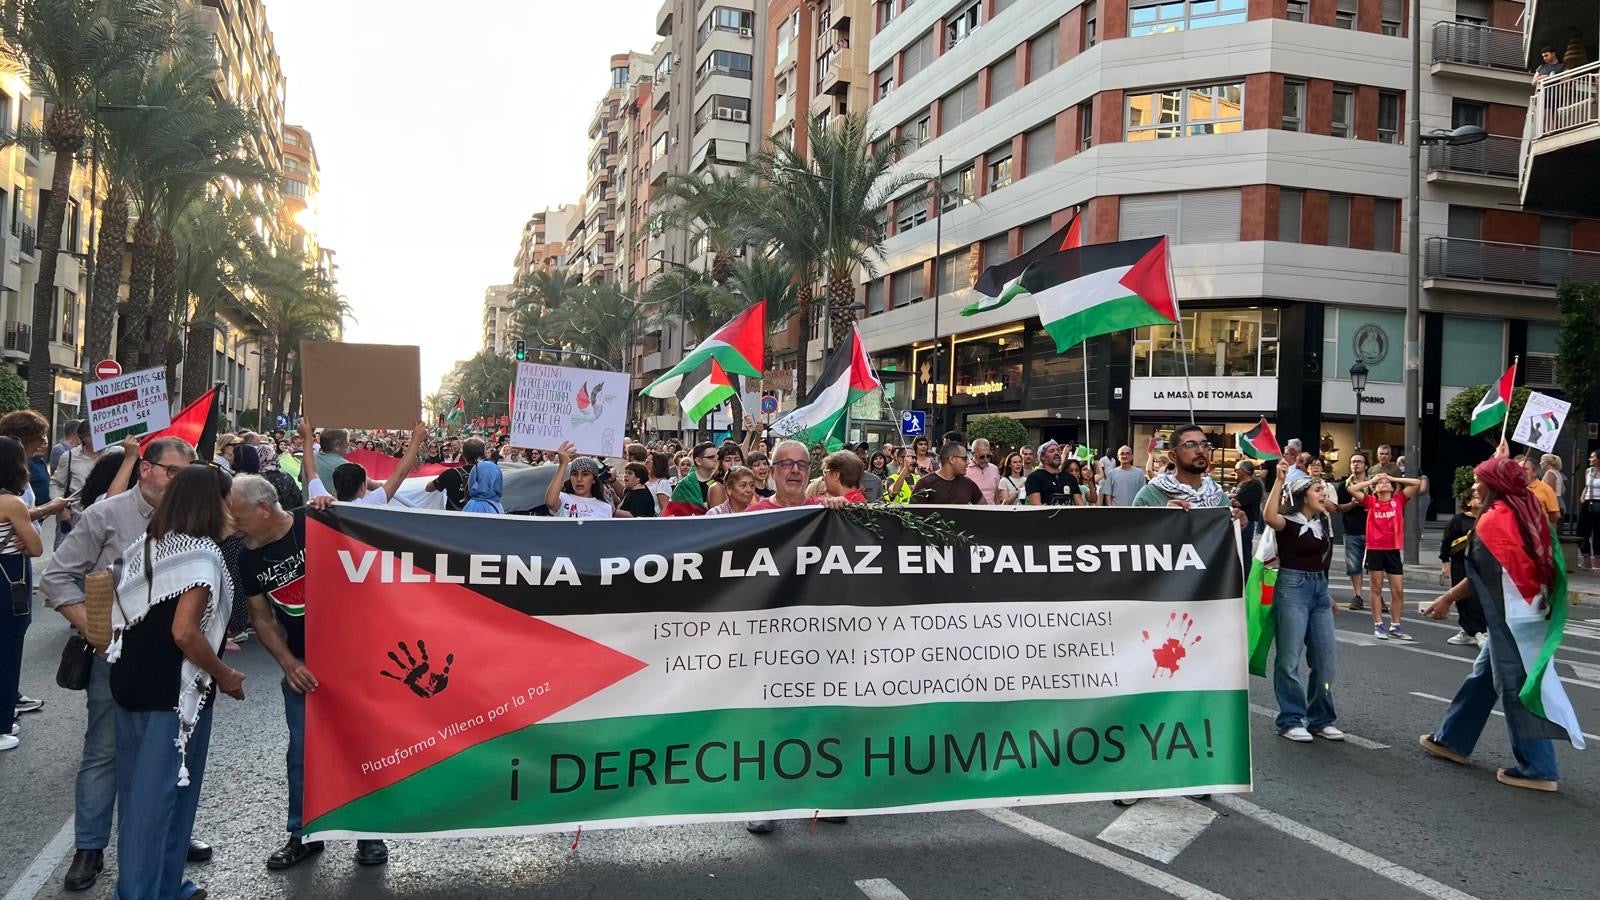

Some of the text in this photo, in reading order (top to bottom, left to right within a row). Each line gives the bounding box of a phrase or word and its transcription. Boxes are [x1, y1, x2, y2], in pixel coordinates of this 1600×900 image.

[96, 371, 165, 396] NO NECESITAS SER
[136, 409, 150, 419] SER
[256, 548, 306, 587] PALESTIN
[276, 570, 298, 586] LIBRE
[337, 543, 1206, 586] VILLENA POR LA PAZ EN PALESTINA
[654, 611, 1112, 640] ¡STOP AL TERRORISMO Y A TODAS LAS VIOLENCIAS!
[666, 642, 1114, 673] ¡ALTO EL FUEGO YA! ¡STOP GENOCIDIO DE ISRAEL!
[763, 672, 1118, 700] ¡CESE DE LA OCUPACIÓN DE PALESTINA!
[361, 682, 551, 775] Plataforma Villena por la Paz
[549, 738, 843, 794] DERECHOS
[865, 725, 1126, 777] HUMANOS
[1138, 718, 1215, 761] YA!
